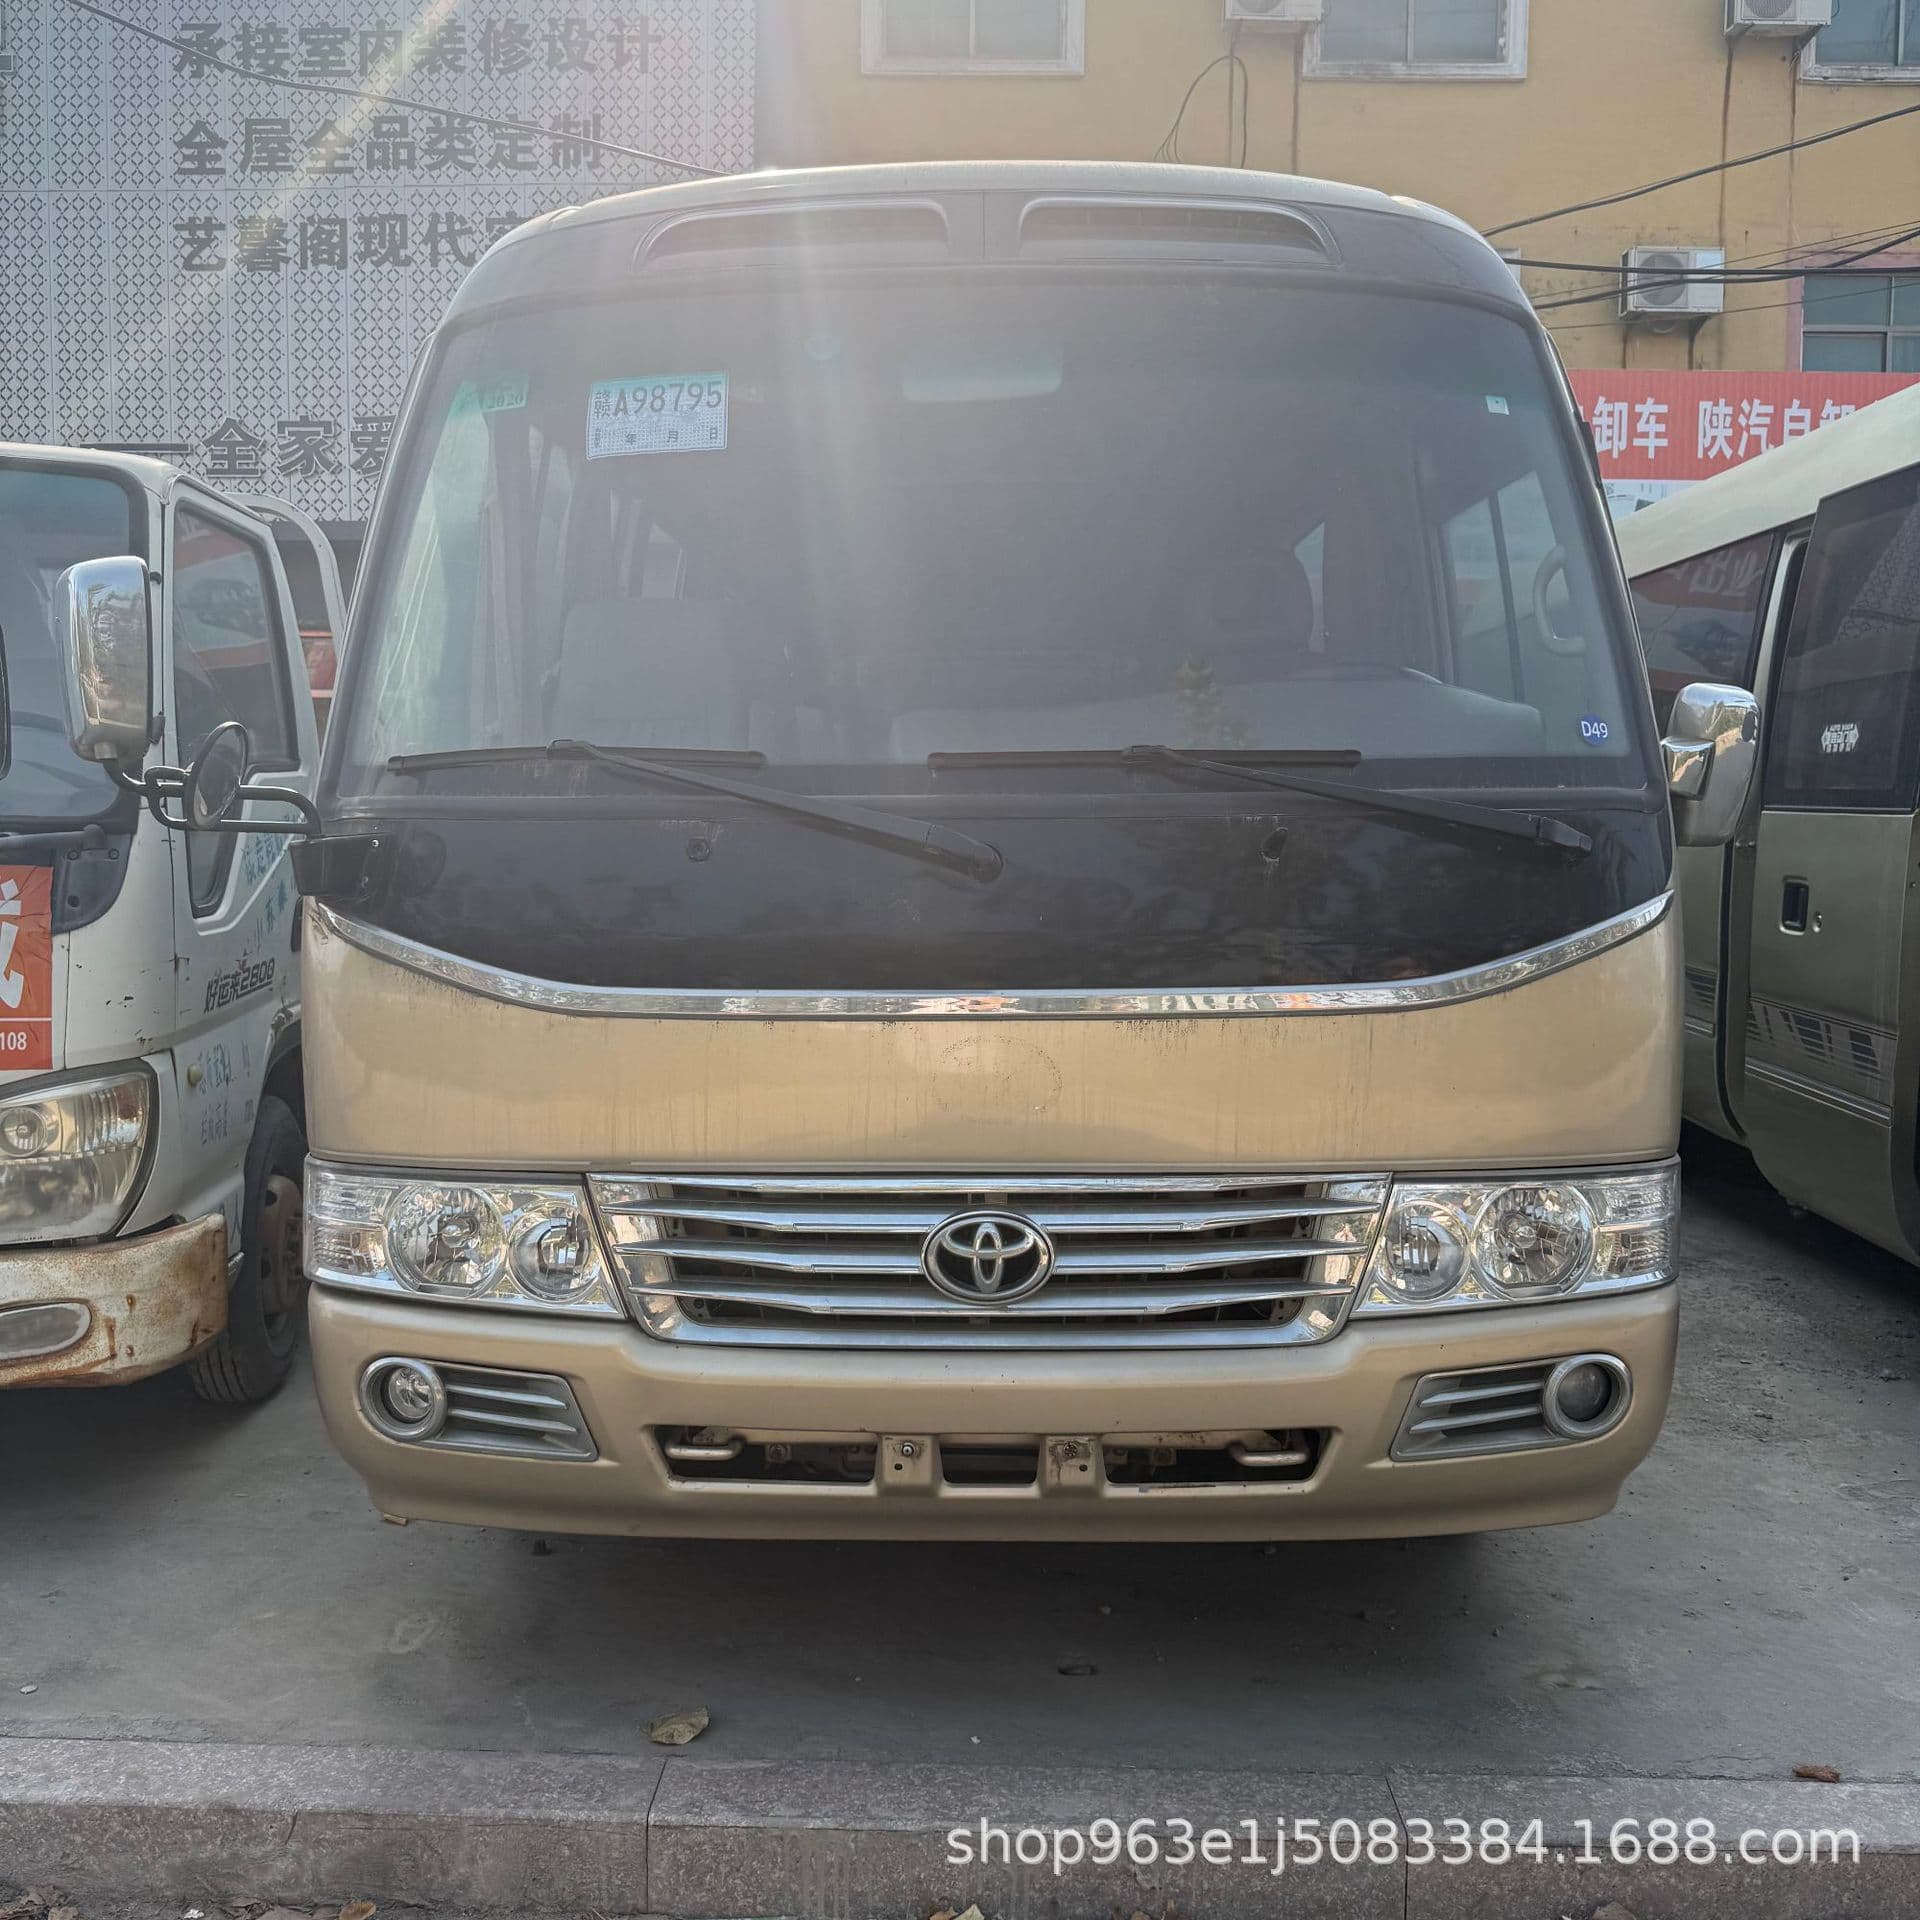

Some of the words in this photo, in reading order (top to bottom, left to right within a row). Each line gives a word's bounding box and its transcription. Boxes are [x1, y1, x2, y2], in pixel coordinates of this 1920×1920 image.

[173, 19, 663, 79] 承接室内装修设计
[174, 114, 602, 176] 全屋全品类定制
[667, 430, 679, 443] 月
[709, 428, 718, 440] 日
[1579, 396, 1668, 459] 卸车
[1581, 720, 1608, 738] D49
